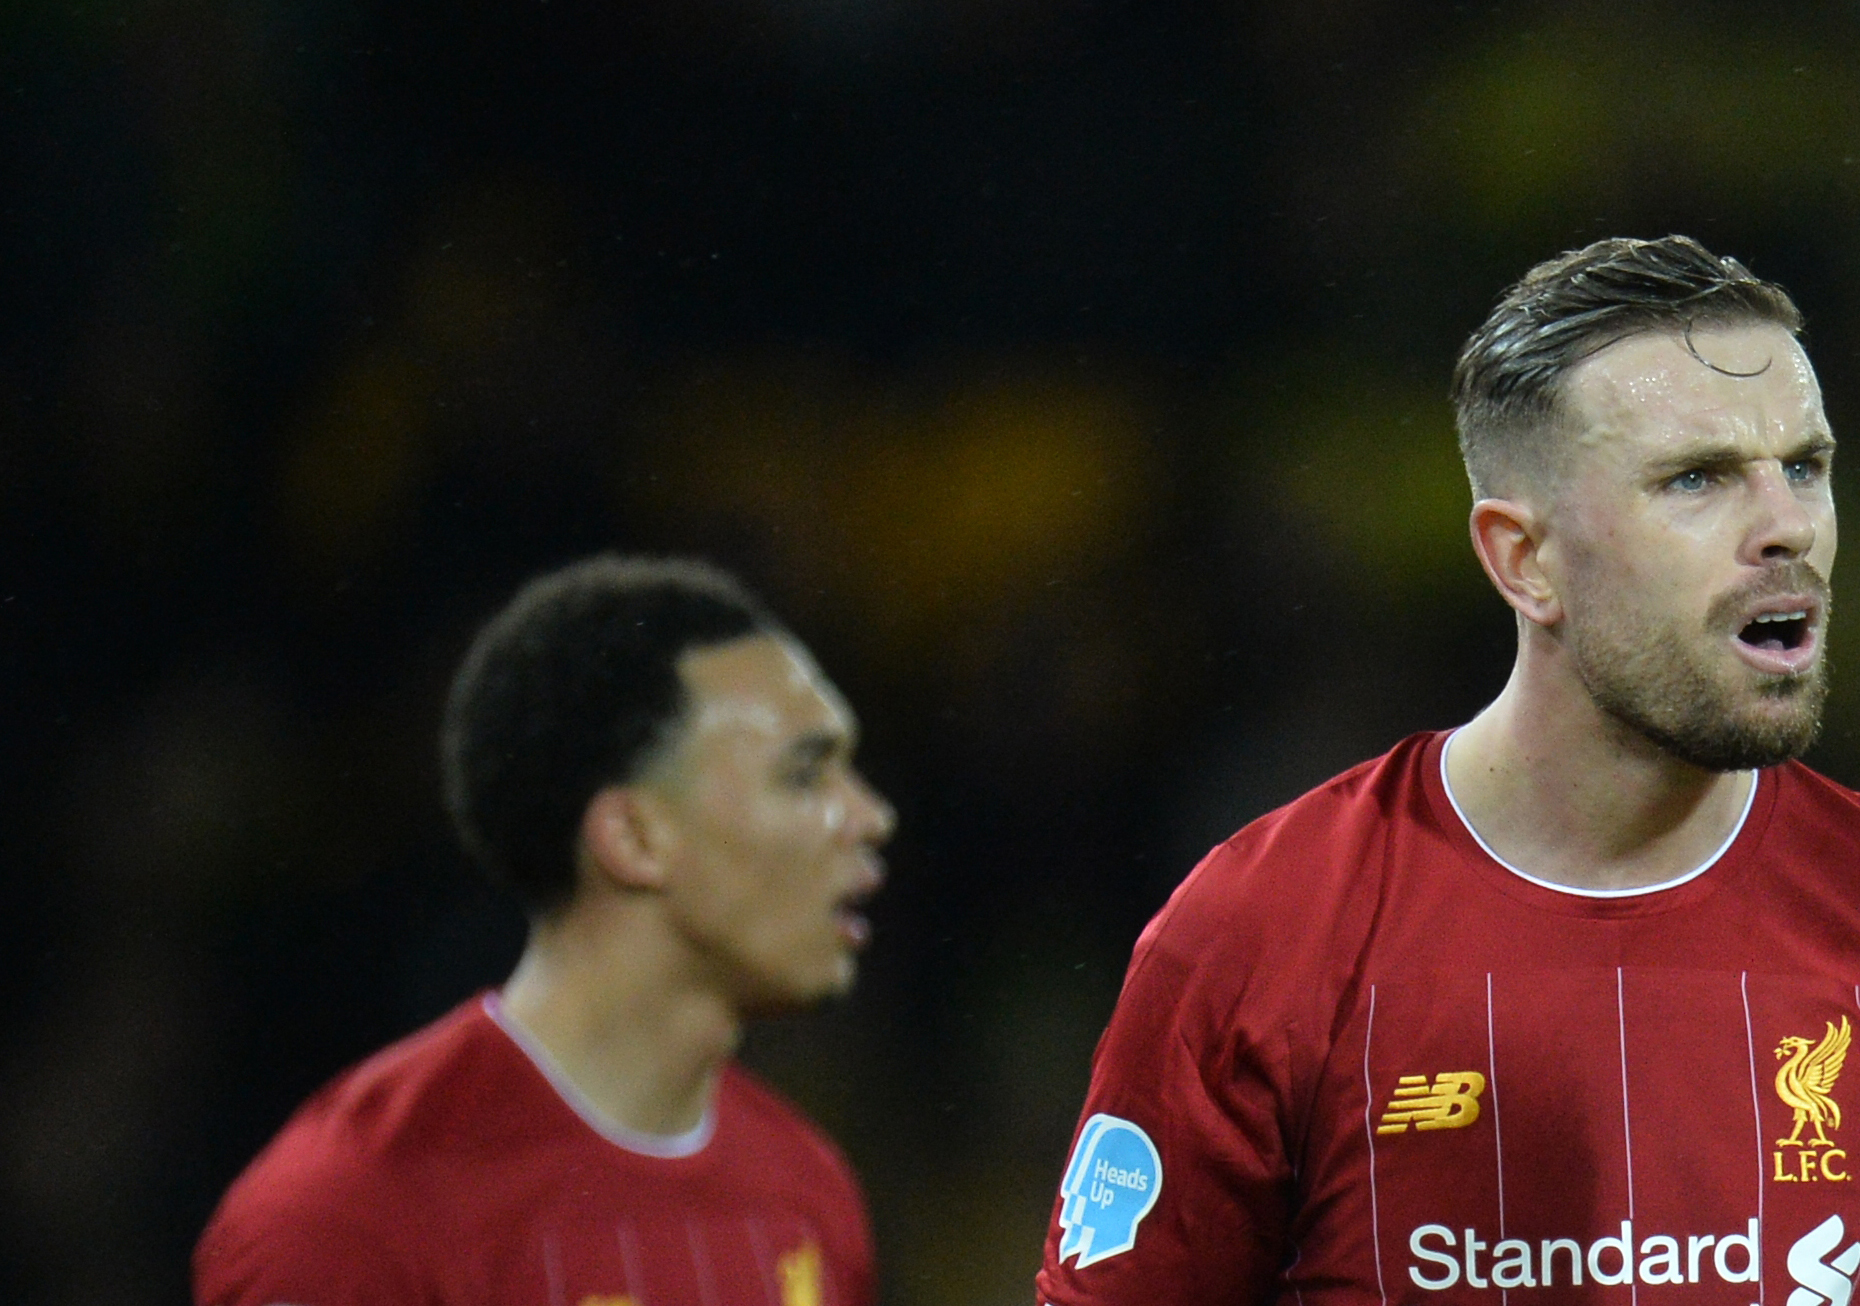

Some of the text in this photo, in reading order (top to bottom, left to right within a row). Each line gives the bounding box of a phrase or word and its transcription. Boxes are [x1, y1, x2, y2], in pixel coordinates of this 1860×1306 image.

[1094, 1158, 1149, 1191] Heads
[1090, 1181, 1115, 1209] Up
[1408, 1217, 1760, 1290] Standard
